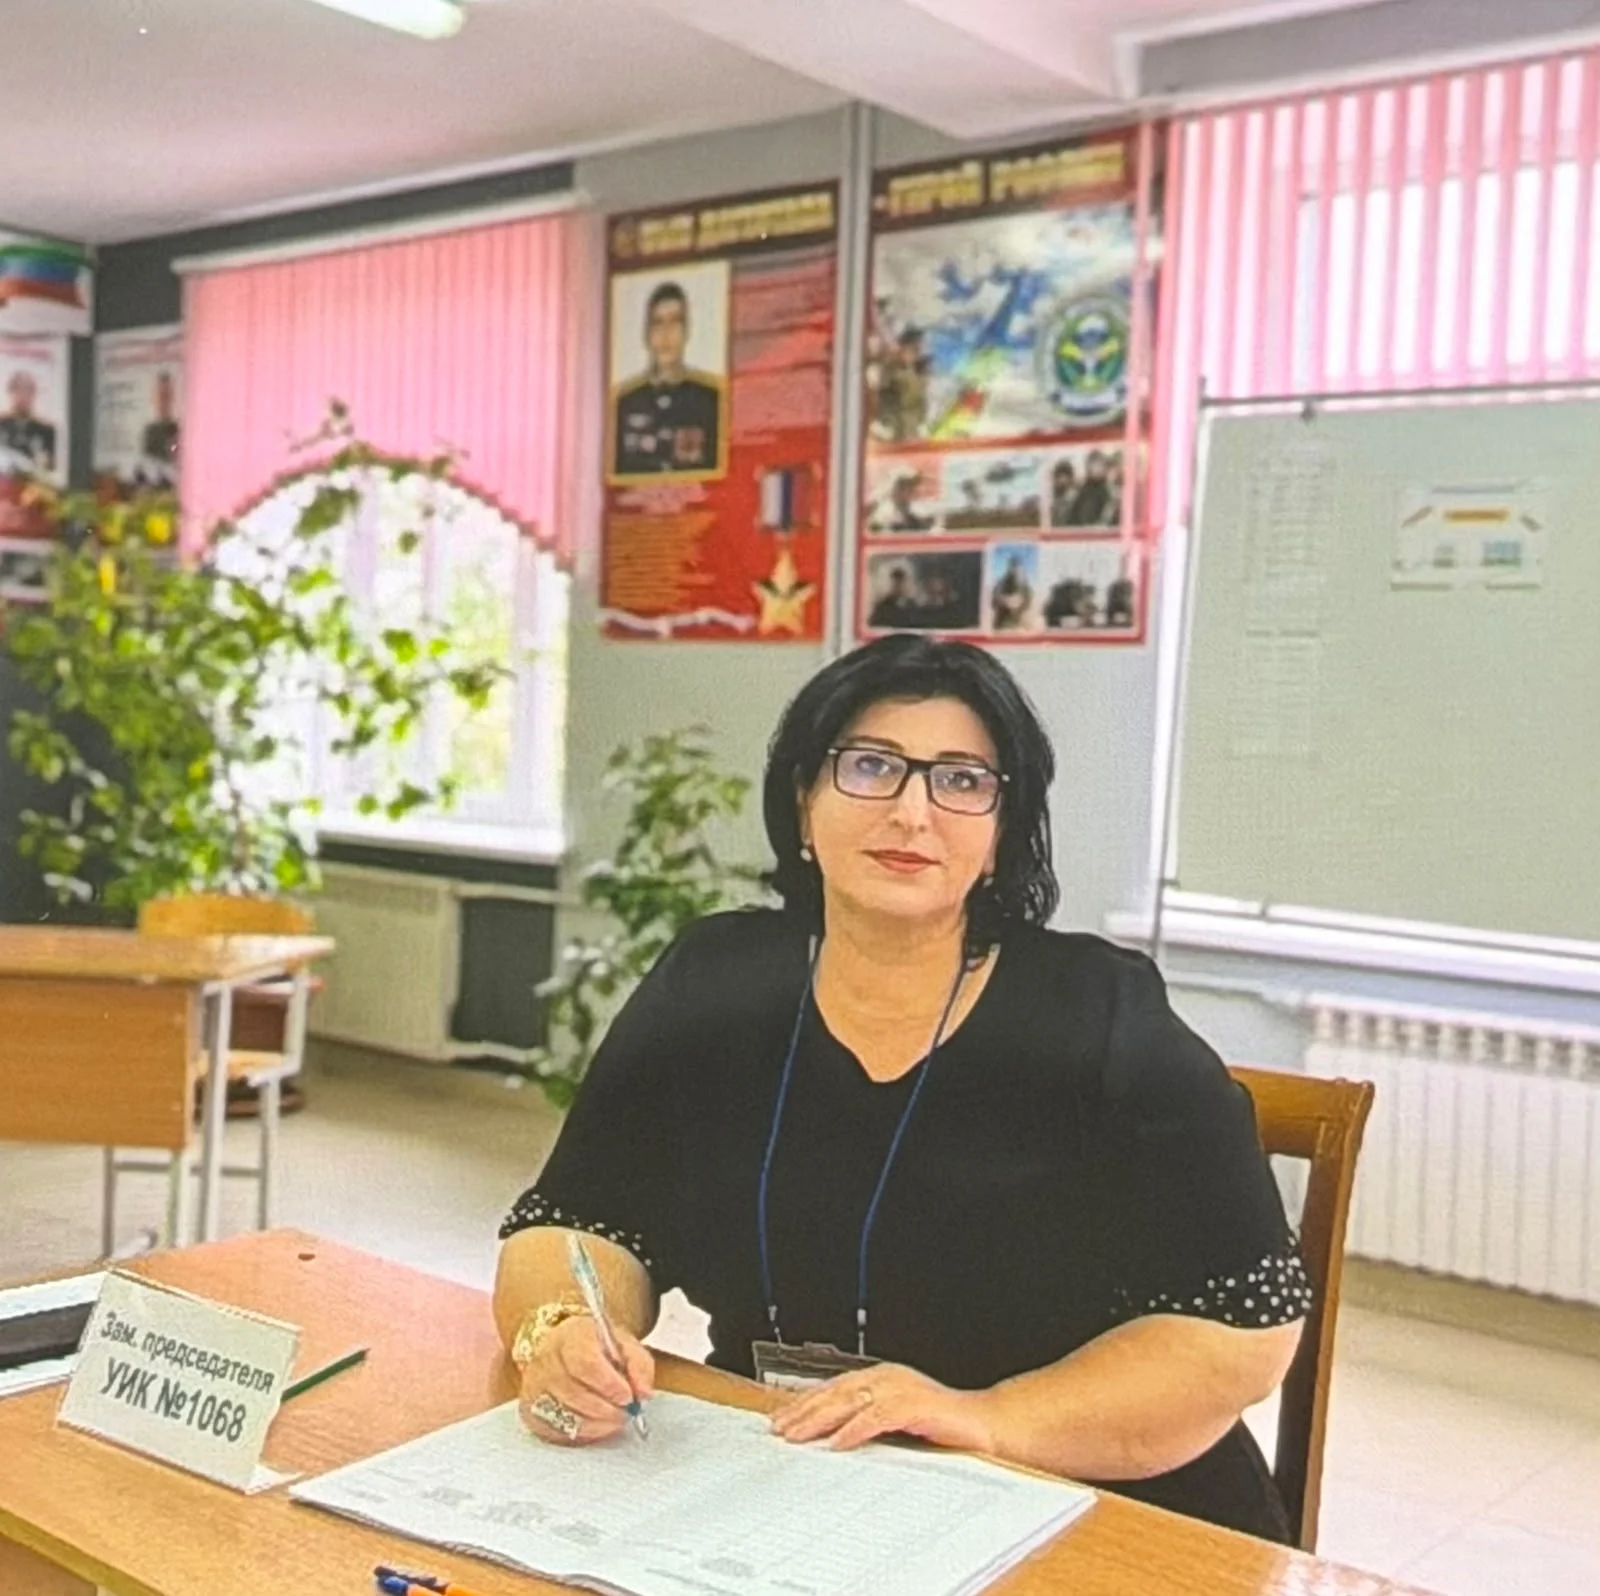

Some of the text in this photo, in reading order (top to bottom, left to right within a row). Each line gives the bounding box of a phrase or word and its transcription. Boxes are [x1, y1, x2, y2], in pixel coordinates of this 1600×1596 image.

[101, 1312, 275, 1394] Зам. председателя
[101, 1357, 246, 1442] УИК №1068
